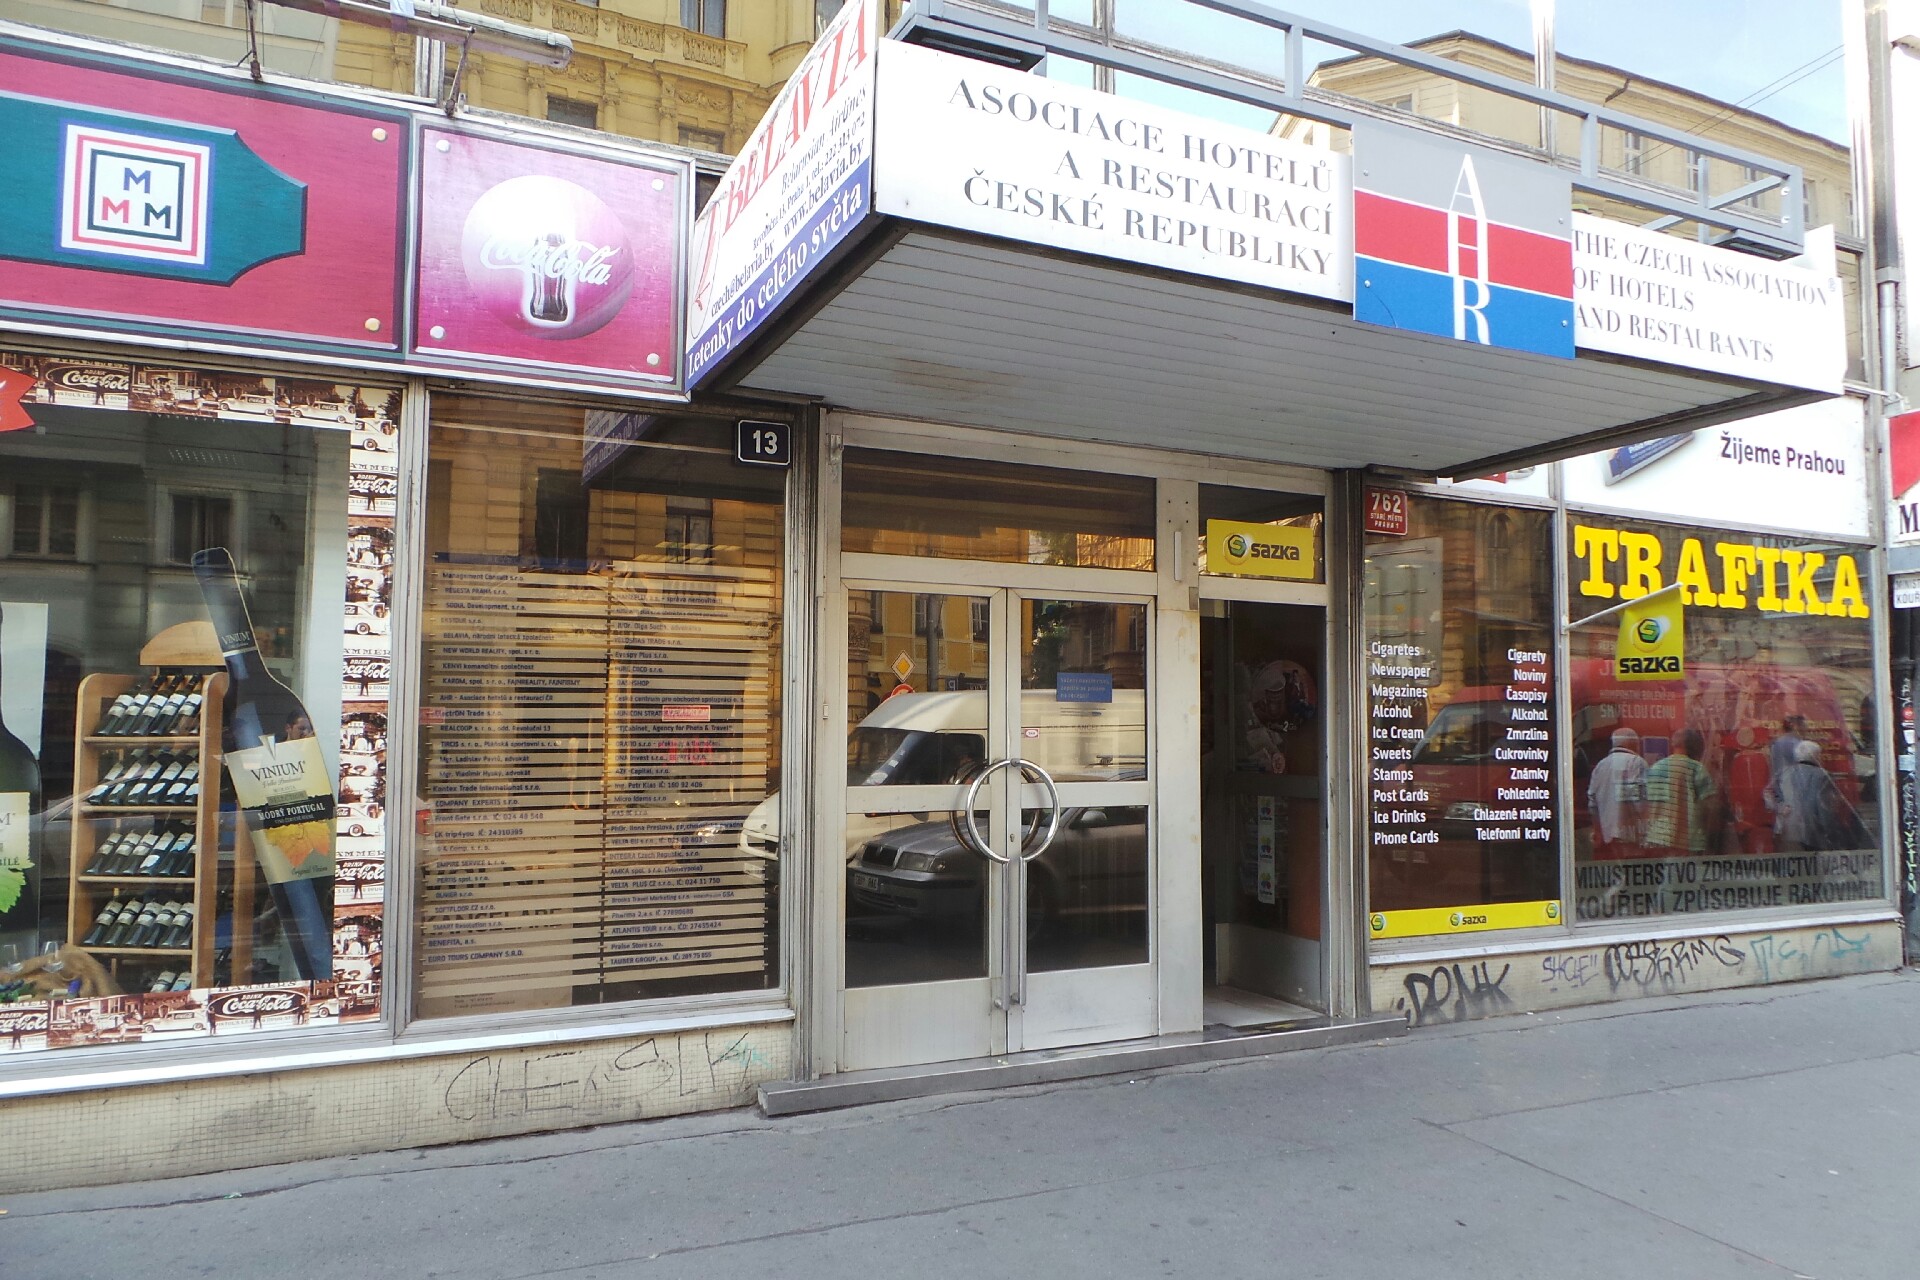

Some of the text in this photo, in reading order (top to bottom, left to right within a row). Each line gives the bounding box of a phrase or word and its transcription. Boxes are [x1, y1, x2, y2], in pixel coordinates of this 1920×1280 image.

[722, 4, 868, 237] BELAVIA
[949, 78, 1332, 193] ASOCIACE HOTELŮ
[1056, 150, 1331, 235] A RESTAURACÍ
[711, 138, 864, 318] czech@belavia.by www.belavia.by
[964, 168, 1333, 276] ČESKÉ REPUBLIKY
[479, 230, 619, 287] Coca-Cola
[1573, 229, 1826, 305] THE CZECH ASSOCIATION
[689, 184, 862, 378] Letenky do celého světa
[1573, 267, 1694, 312] OF HOTELS
[1575, 305, 1773, 362] AND RESTAURANTS
[62, 370, 129, 390] Coca-Col
[752, 429, 779, 454] 13
[1719, 424, 1846, 476] Žijeme Prahou
[1372, 492, 1401, 513] 762
[1250, 542, 1300, 561] sazka
[1574, 524, 1870, 619] TRAFIKA
[1371, 642, 1420, 657] Cigaretes
[1508, 649, 1546, 664] Cigarety
[1372, 663, 1431, 678] Newspaper
[1619, 655, 1680, 674] sazka
[1514, 669, 1546, 684] Noviny
[1373, 684, 1428, 699] Magazines
[1506, 685, 1547, 703] Časopisy
[1373, 705, 1412, 719] Alcohol
[1512, 709, 1548, 721] Alkohol
[1373, 727, 1424, 739] Ice Cream
[1506, 728, 1548, 740] Zmrzlina
[1373, 748, 1412, 760] Sweets
[1495, 748, 1549, 762] Cukrovinky
[251, 761, 304, 781] VINIUM
[1373, 768, 1413, 783] Stamps
[1510, 768, 1549, 782] Známky
[1374, 789, 1429, 802] Post Cards
[1498, 787, 1549, 800] Pohlednice
[258, 807, 285, 820] MODRÝ
[1374, 810, 1426, 823] Ice Drinks
[1474, 807, 1551, 821] Chlazené nápoje
[1375, 831, 1439, 845] Phone Cards
[1476, 828, 1550, 841] Telefonní karty
[1575, 862, 1695, 888] MINISTERSTVO
[1703, 853, 1818, 882] ZDRAVOTNICTVÍ
[1575, 890, 1665, 920] KOUŘENÍ
[1673, 884, 1781, 912] ZPŮSOBUJE
[1461, 912, 1487, 925] sazka
